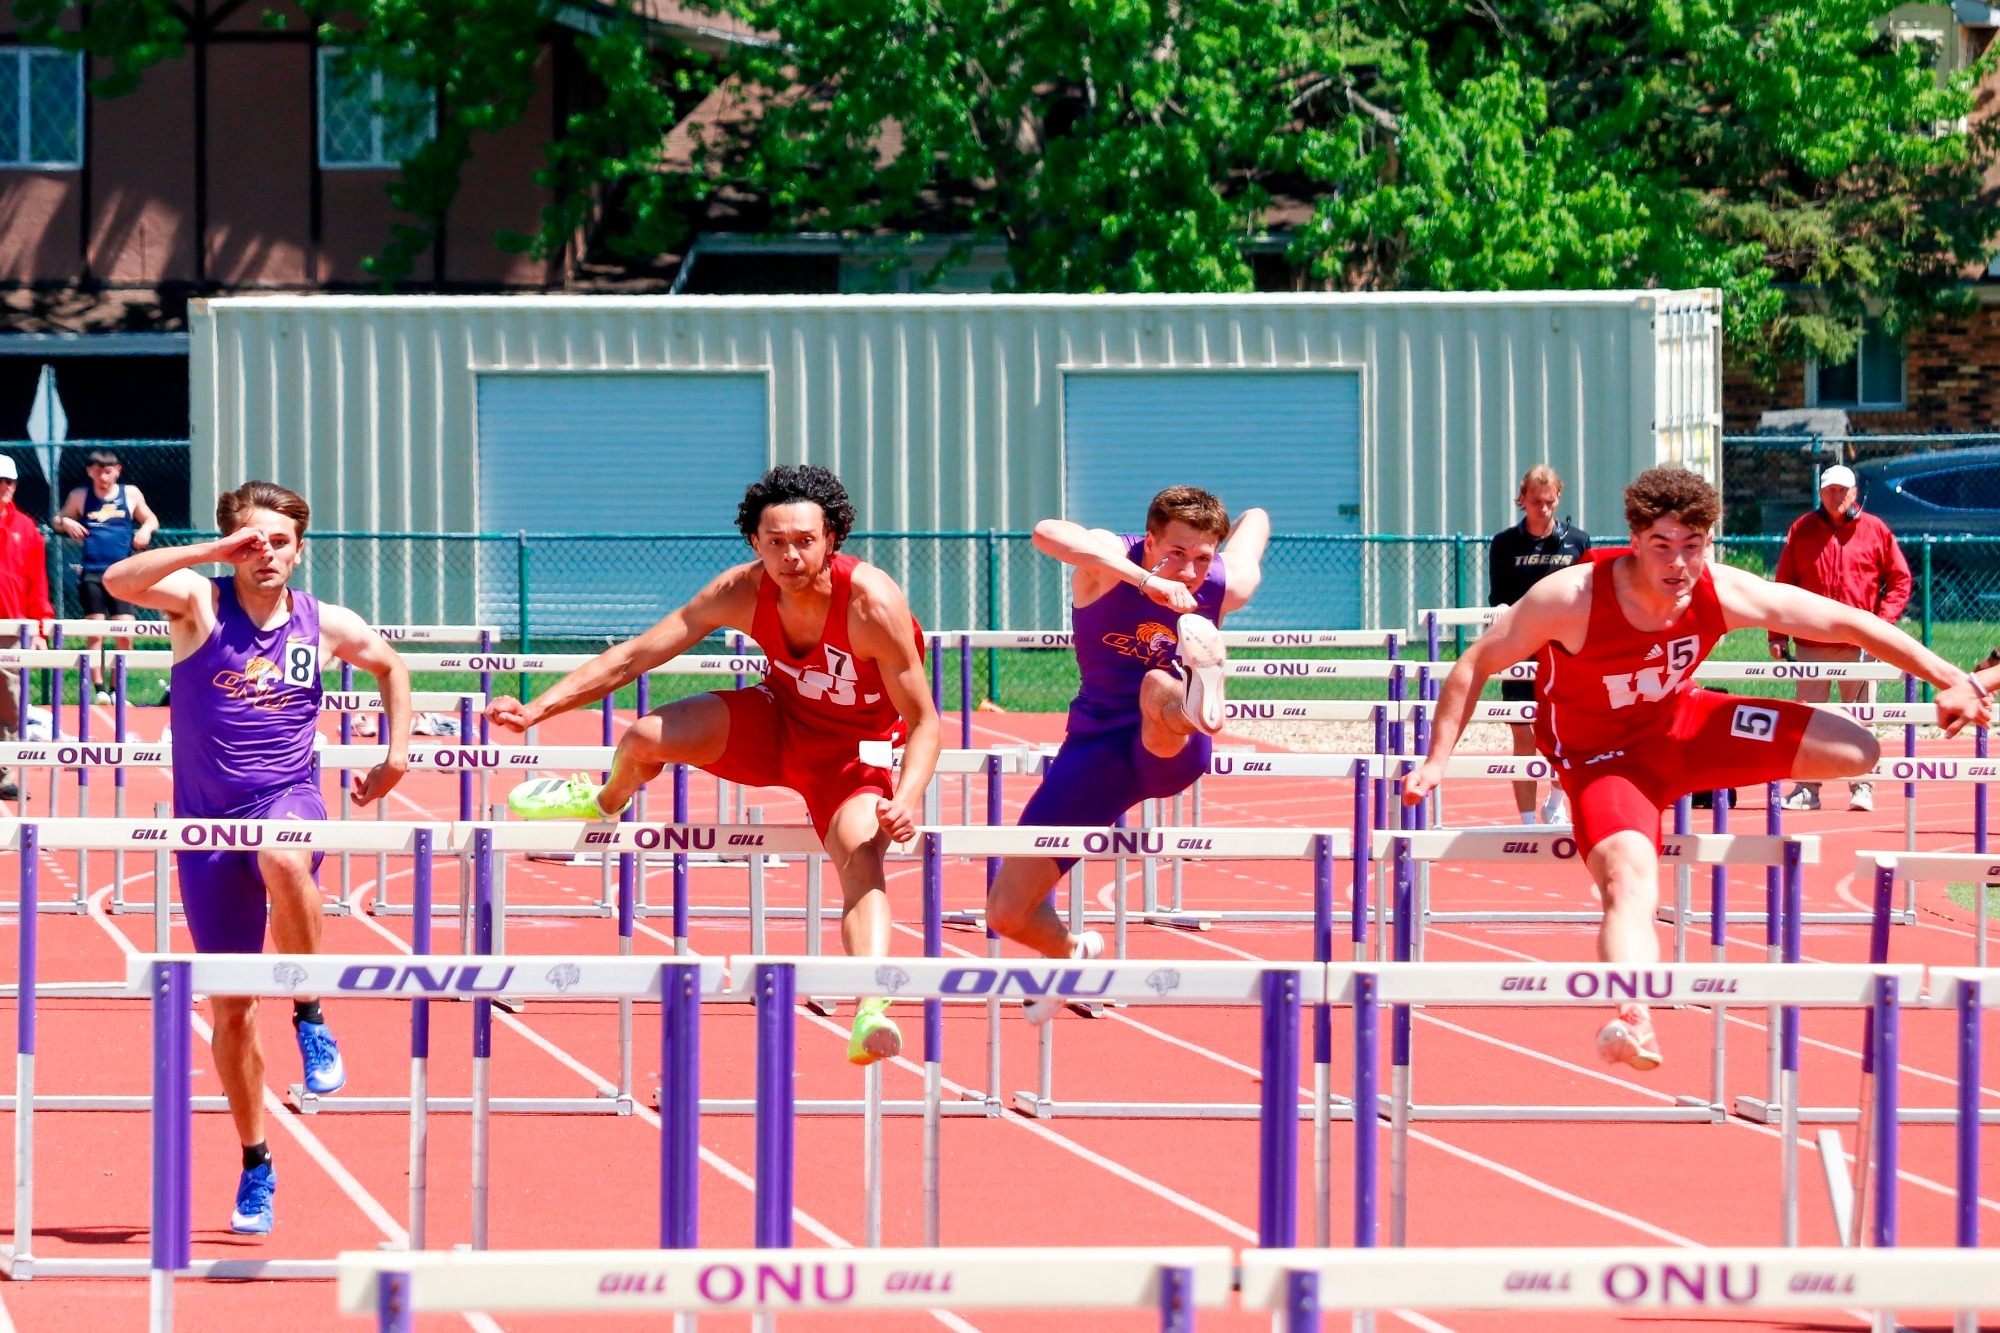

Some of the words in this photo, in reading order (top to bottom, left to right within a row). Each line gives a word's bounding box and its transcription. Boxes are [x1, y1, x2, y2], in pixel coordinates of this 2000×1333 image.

[1515, 554, 1573, 566] TIGERS
[1042, 634, 1073, 644] ON
[1272, 634, 1312, 643] ONU
[469, 657, 515, 669] ONU
[826, 647, 848, 676] 7
[1672, 638, 1694, 671] 5
[291, 647, 311, 682] 8
[1263, 663, 1309, 675] ONU
[1510, 665, 1538, 678] ON
[1772, 665, 1819, 677] ONU
[320, 695, 360, 710] NU
[1225, 704, 1274, 718] ONU
[1487, 708, 1511, 716] GILL
[1734, 711, 1772, 736] 5
[18, 750, 45, 759] GILL
[57, 747, 122, 764] ONU
[133, 753, 161, 761] GILL
[435, 749, 499, 767] ONU
[510, 754, 538, 764] GILL
[1243, 762, 1271, 771] GILL
[1487, 764, 1515, 773] GILL
[1892, 762, 1958, 779] ONU
[1968, 766, 1996, 775] GILL
[132, 829, 167, 839] GILL
[182, 824, 262, 846] ONU
[276, 831, 311, 842] GILL
[585, 832, 620, 843] GILL
[635, 827, 715, 849] ONU
[728, 834, 763, 845] GILL
[1035, 836, 1069, 847] GILL
[1084, 831, 1163, 854] ONU
[1177, 838, 1211, 849] GILL
[1503, 842, 1538, 853] GILL
[338, 966, 514, 992] ONU
[939, 968, 1114, 996] ONU
[1501, 976, 1546, 991] GILL
[1567, 971, 1672, 998] ONU
[1692, 978, 1736, 993] GILL
[598, 1273, 664, 1294] GILL
[697, 1265, 856, 1303] ONU
[884, 1273, 953, 1293] GILL
[1505, 1273, 1571, 1293] GILL
[1604, 1265, 1759, 1304] ONU
[1789, 1274, 1855, 1293] GILL
